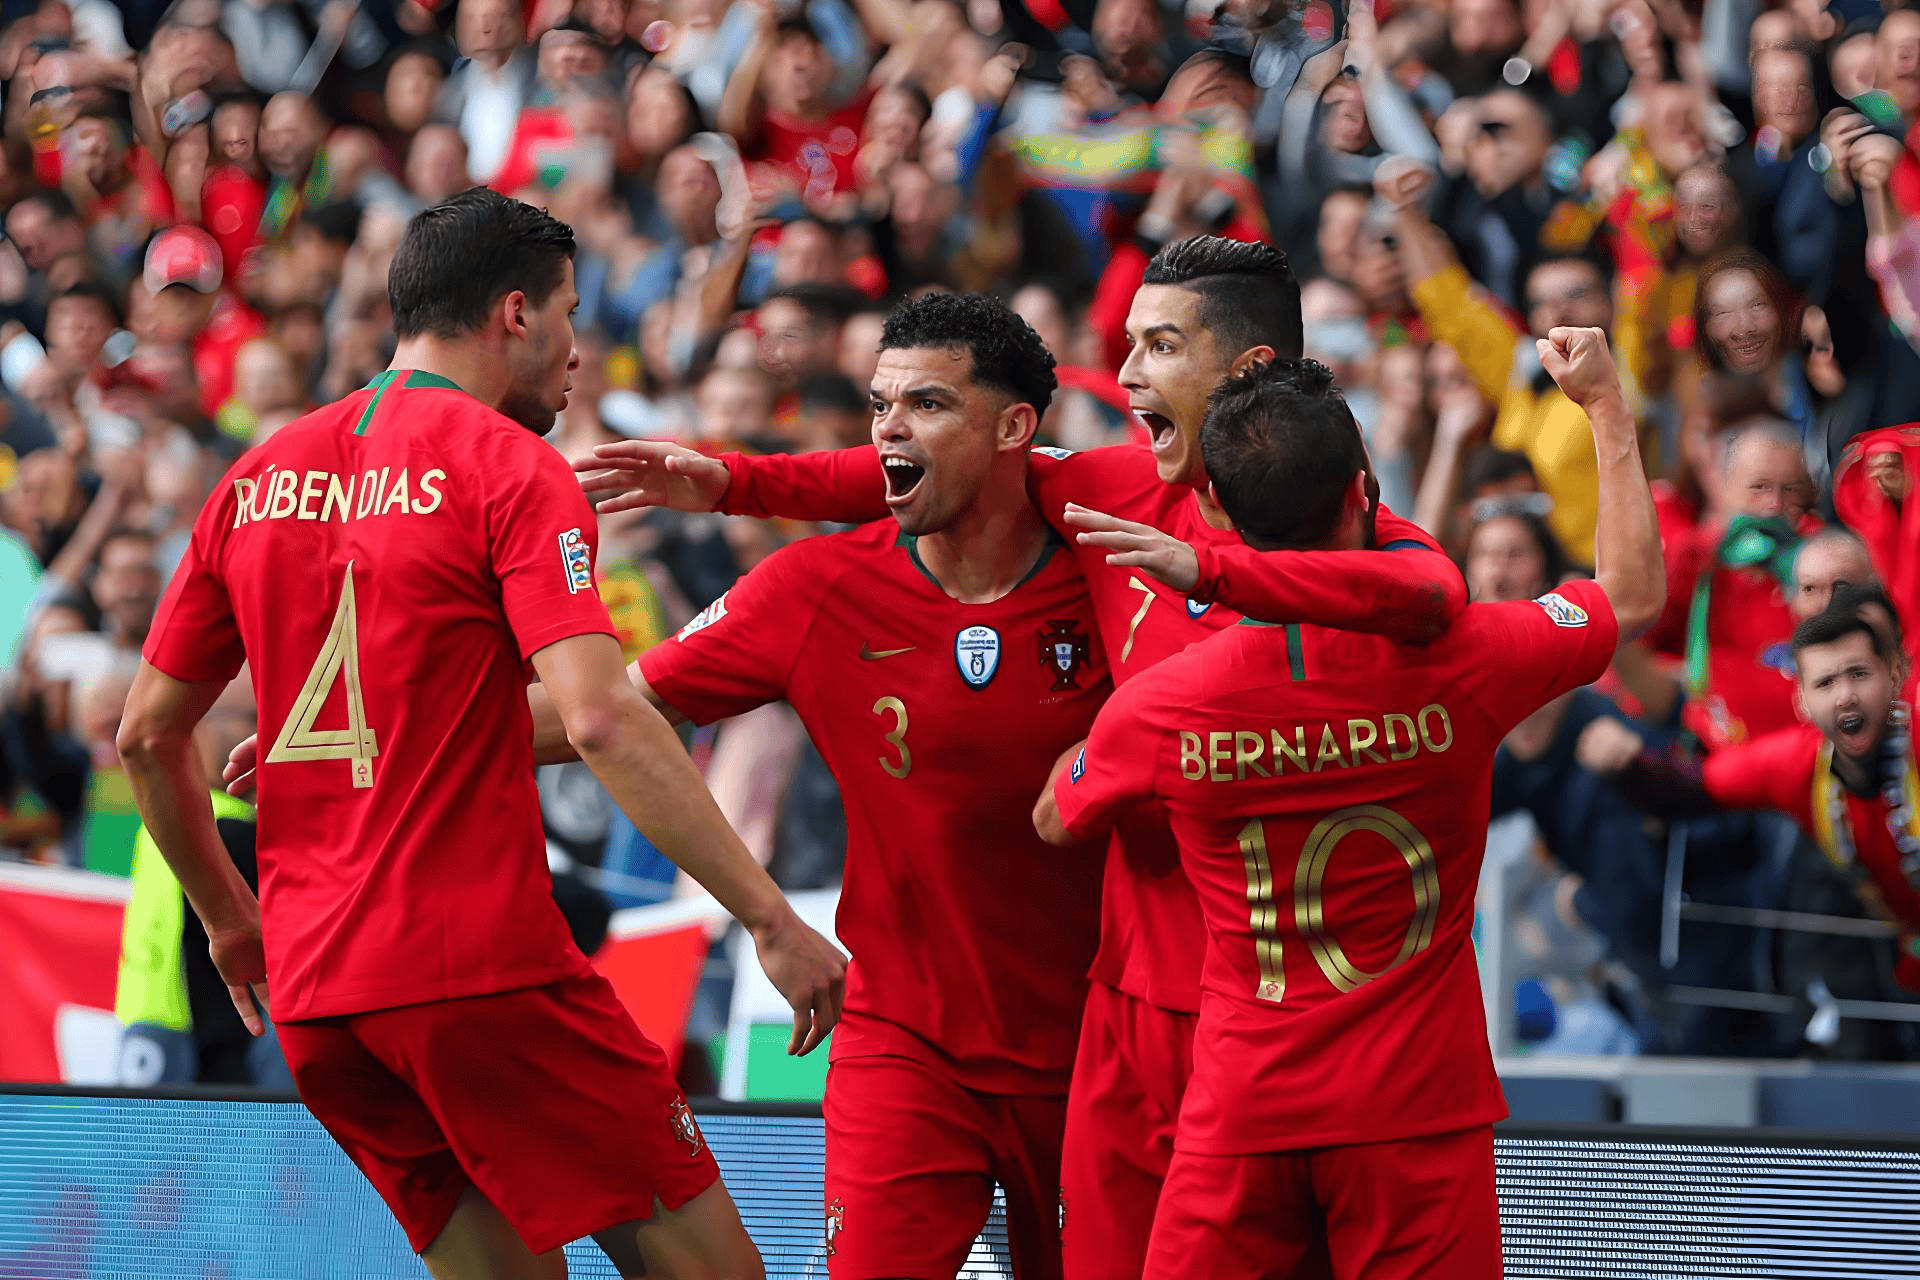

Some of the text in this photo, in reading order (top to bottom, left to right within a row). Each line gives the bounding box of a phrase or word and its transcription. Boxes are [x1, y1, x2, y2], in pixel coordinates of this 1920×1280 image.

[1121, 575, 1157, 664] 7
[264, 559, 379, 788] 4
[872, 695, 912, 779] 3
[1179, 703, 1453, 782] BERNARDO
[1236, 804, 1441, 1003] 10
